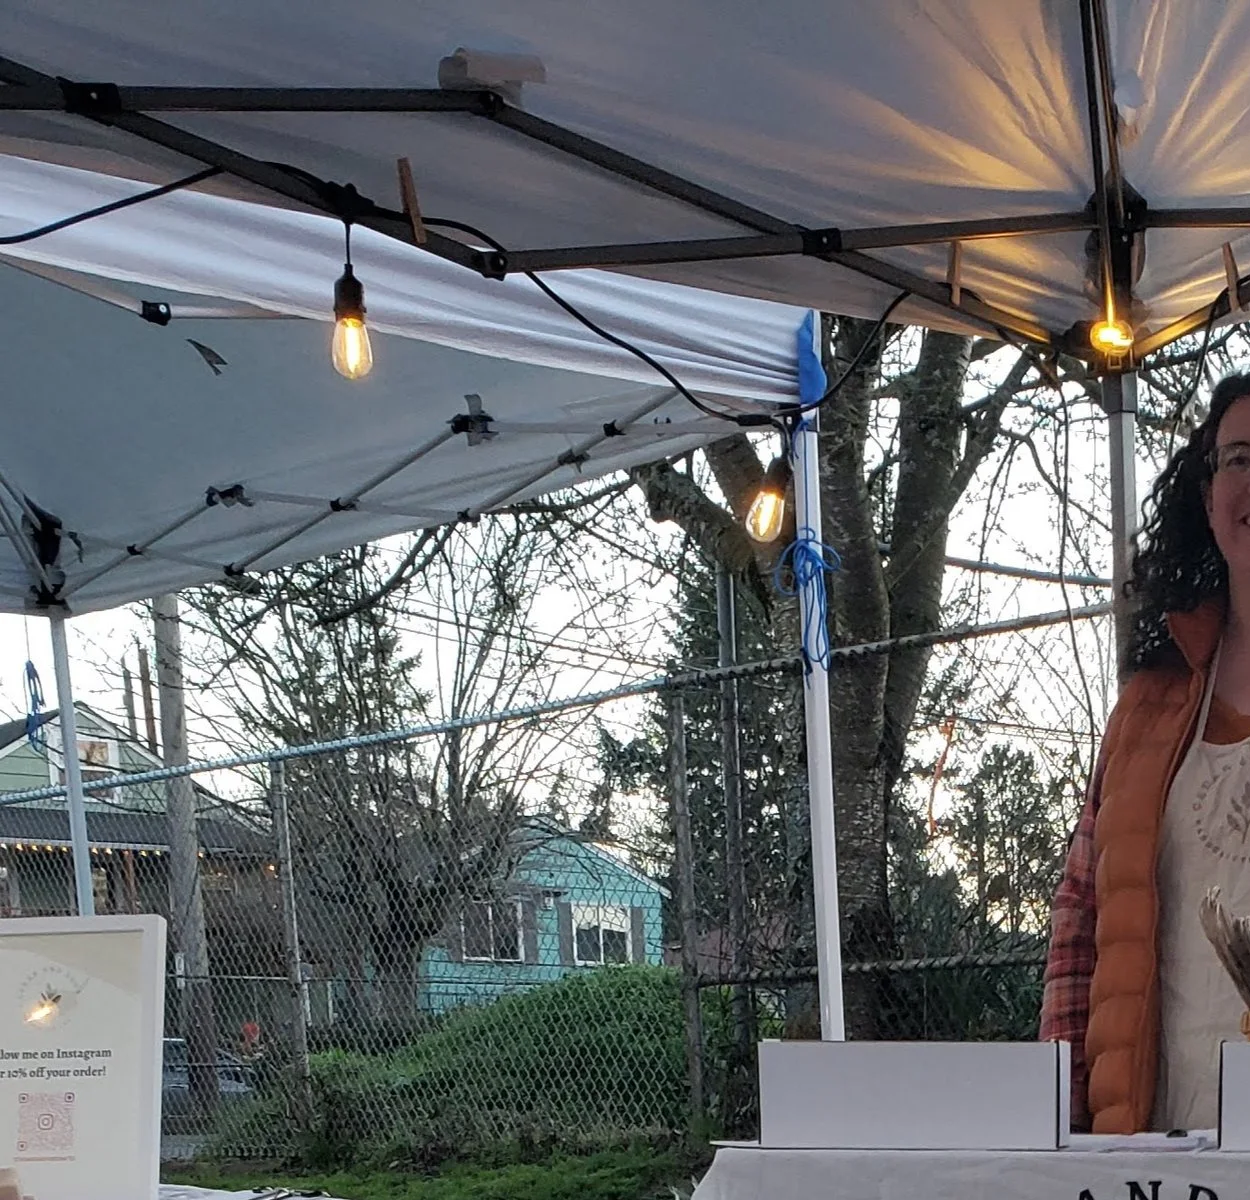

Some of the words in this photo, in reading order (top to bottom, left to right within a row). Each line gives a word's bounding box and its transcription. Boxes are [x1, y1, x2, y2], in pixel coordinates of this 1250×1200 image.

[22, 1050, 39, 1060] me
[40, 1050, 54, 1060] on
[56, 1048, 112, 1061] Instagram
[7, 1067, 27, 1079] 10%
[29, 1066, 46, 1078] off
[46, 1069, 71, 1080] your
[73, 1065, 106, 1077] order!
